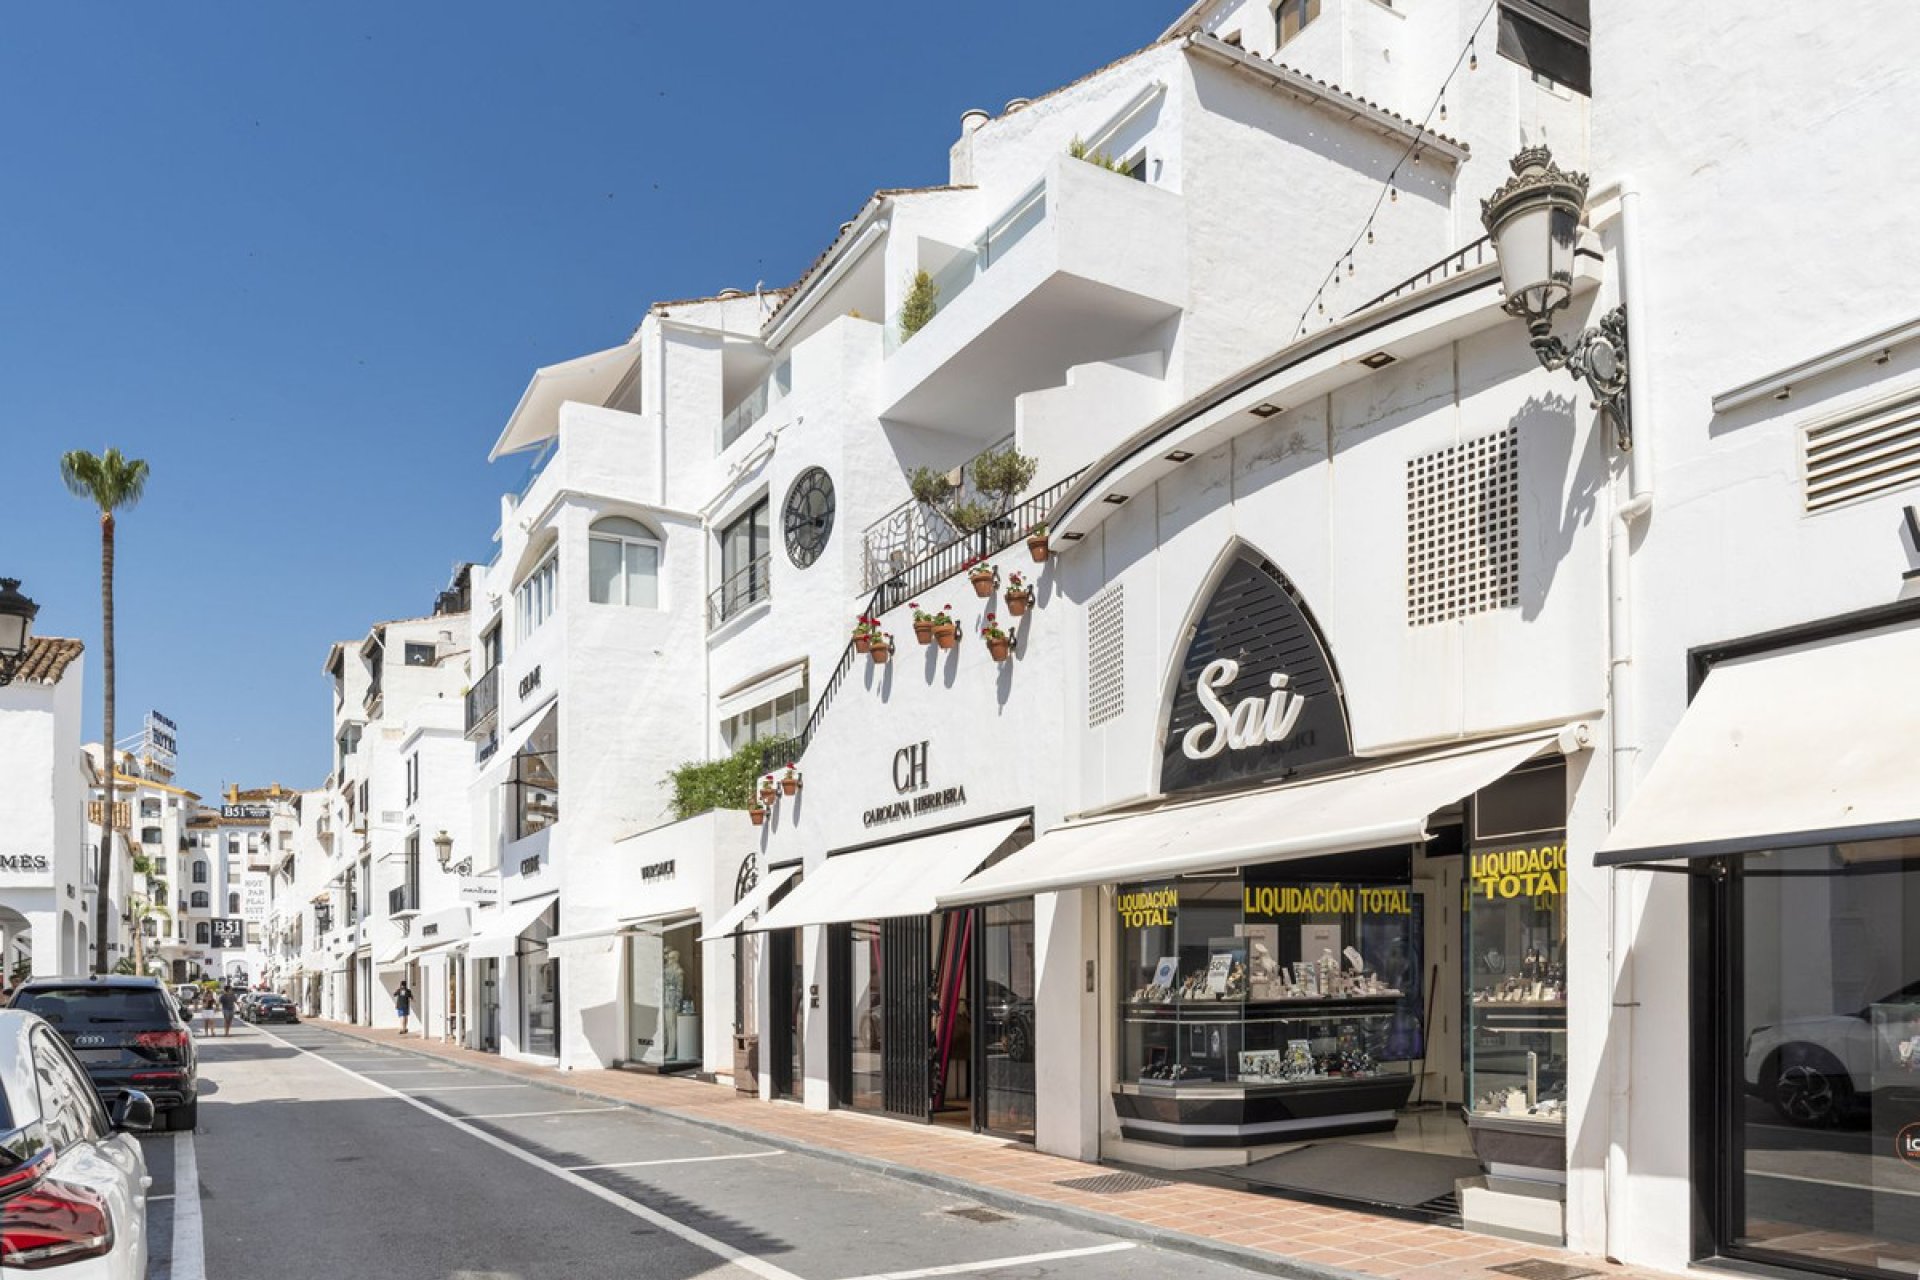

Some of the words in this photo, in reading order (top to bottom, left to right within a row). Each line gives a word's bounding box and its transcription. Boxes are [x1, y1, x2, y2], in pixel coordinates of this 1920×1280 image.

[1182, 658, 1304, 759] Sai
[893, 740, 930, 793] CH
[863, 800, 912, 828] CAROLINA
[913, 785, 967, 816] HERRERA
[1117, 886, 1178, 912] LIQUIDACIÓN
[1122, 908, 1173, 928] TOTAL
[1245, 882, 1354, 917] LIQUIDACIÓN
[1360, 889, 1411, 913] TOTAL
